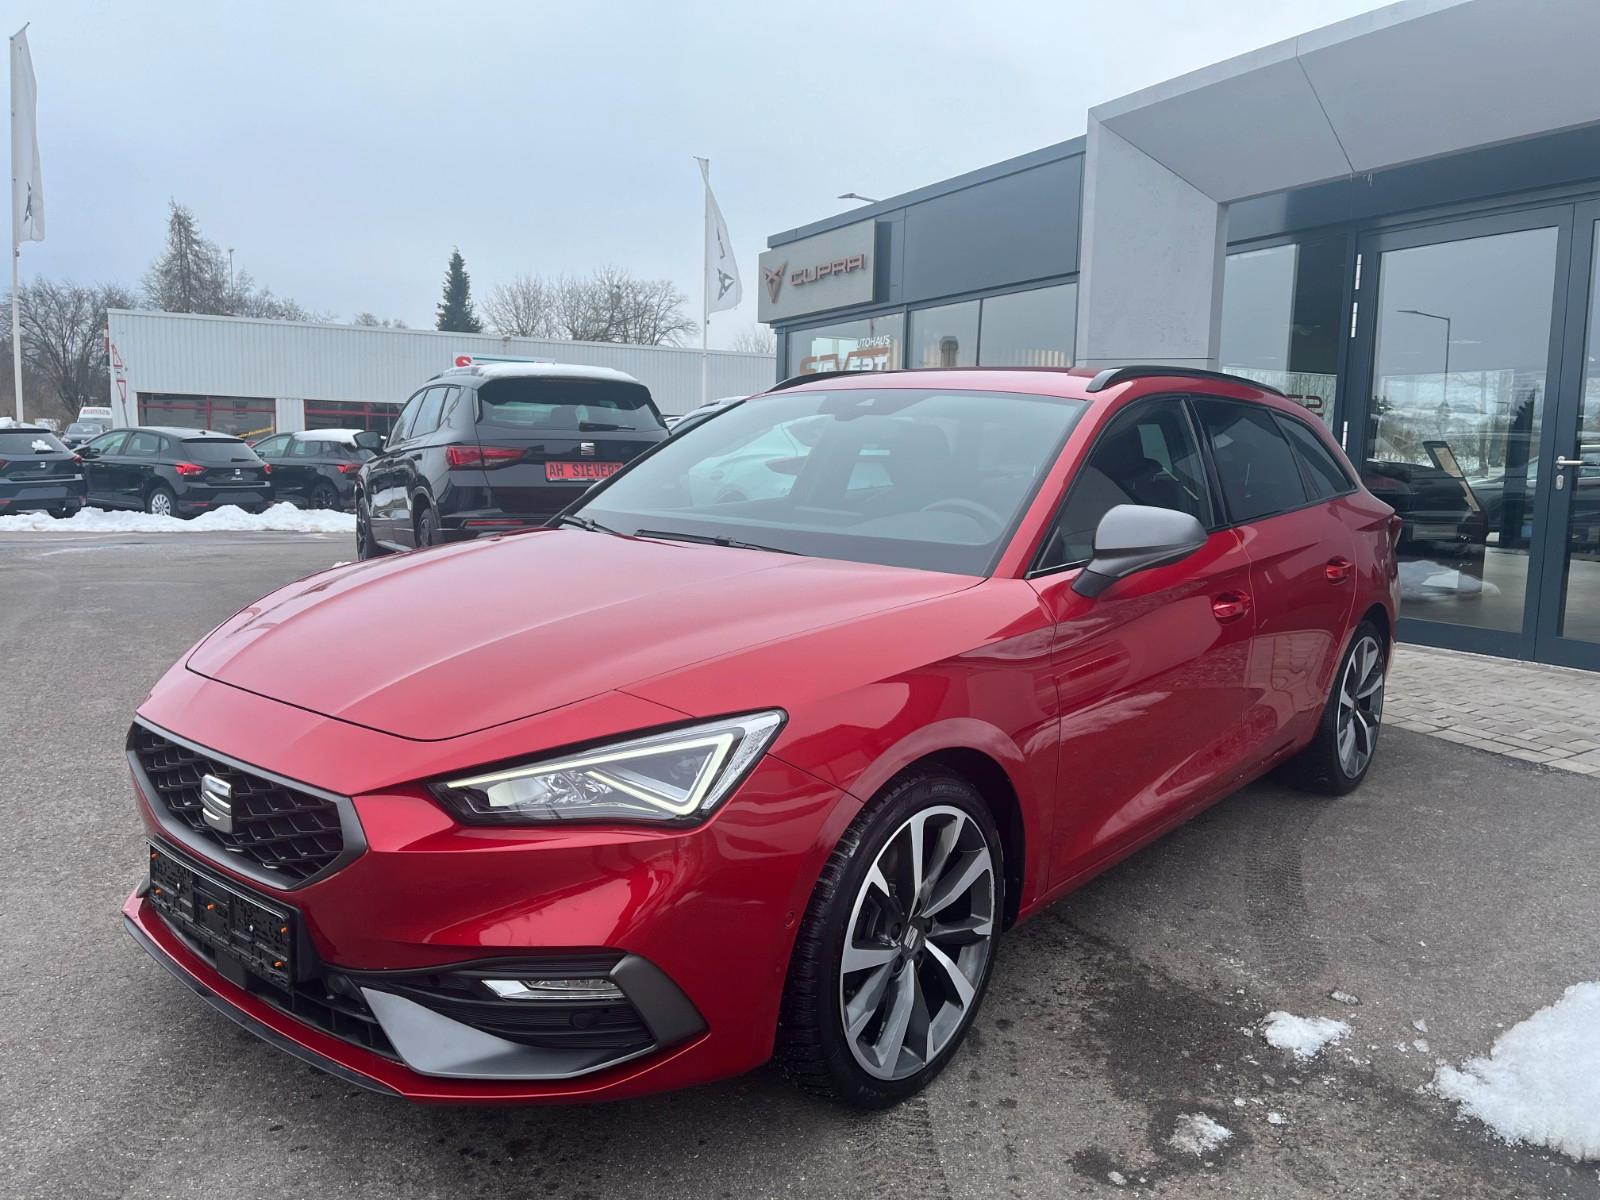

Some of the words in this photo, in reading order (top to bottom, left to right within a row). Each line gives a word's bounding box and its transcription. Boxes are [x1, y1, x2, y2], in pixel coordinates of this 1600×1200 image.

[791, 254, 864, 286] CUPRA
[854, 334, 890, 349] UTOHAUS
[549, 463, 564, 477] AH
